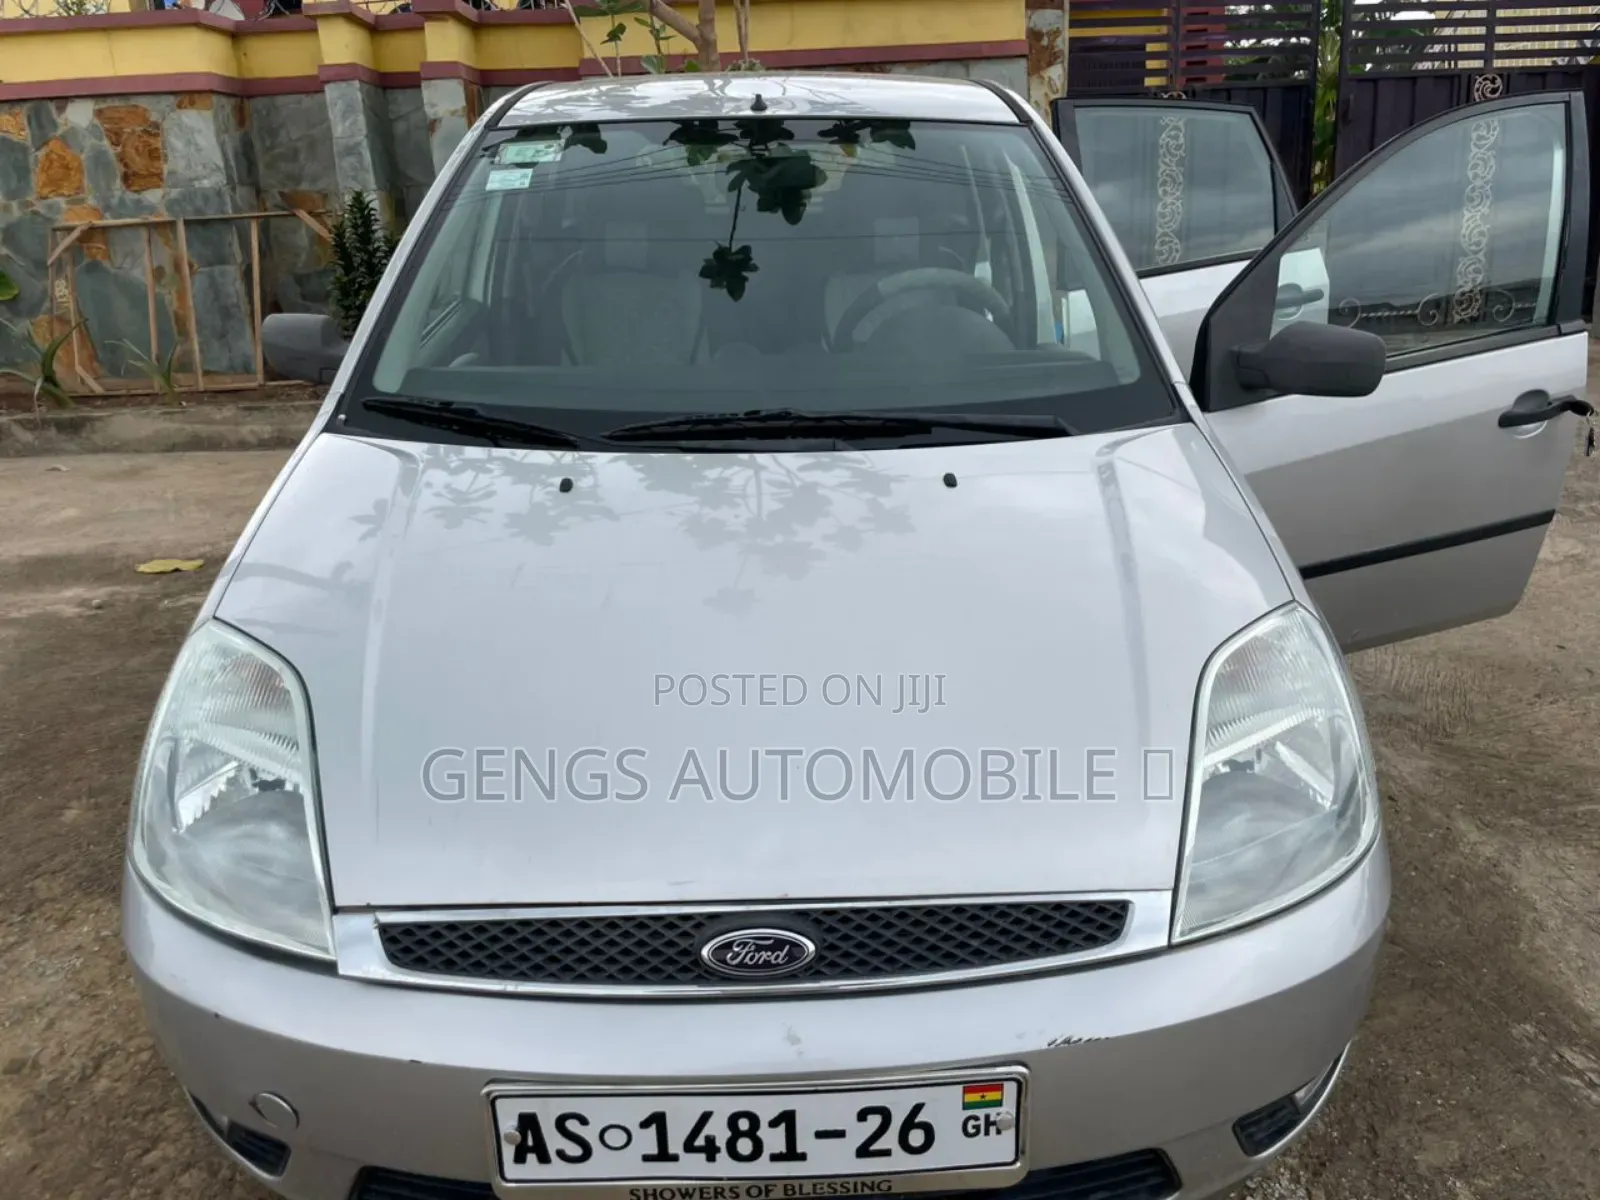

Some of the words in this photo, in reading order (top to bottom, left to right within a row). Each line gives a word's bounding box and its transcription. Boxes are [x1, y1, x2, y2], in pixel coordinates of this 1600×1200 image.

[726, 938, 790, 965] Ford
[638, 1102, 936, 1163] 1481-26
[961, 1113, 1002, 1139] GH
[628, 1184, 741, 1200] SHOWERS
[745, 1183, 778, 1199] OF
[782, 1179, 893, 1198] BLESSING
